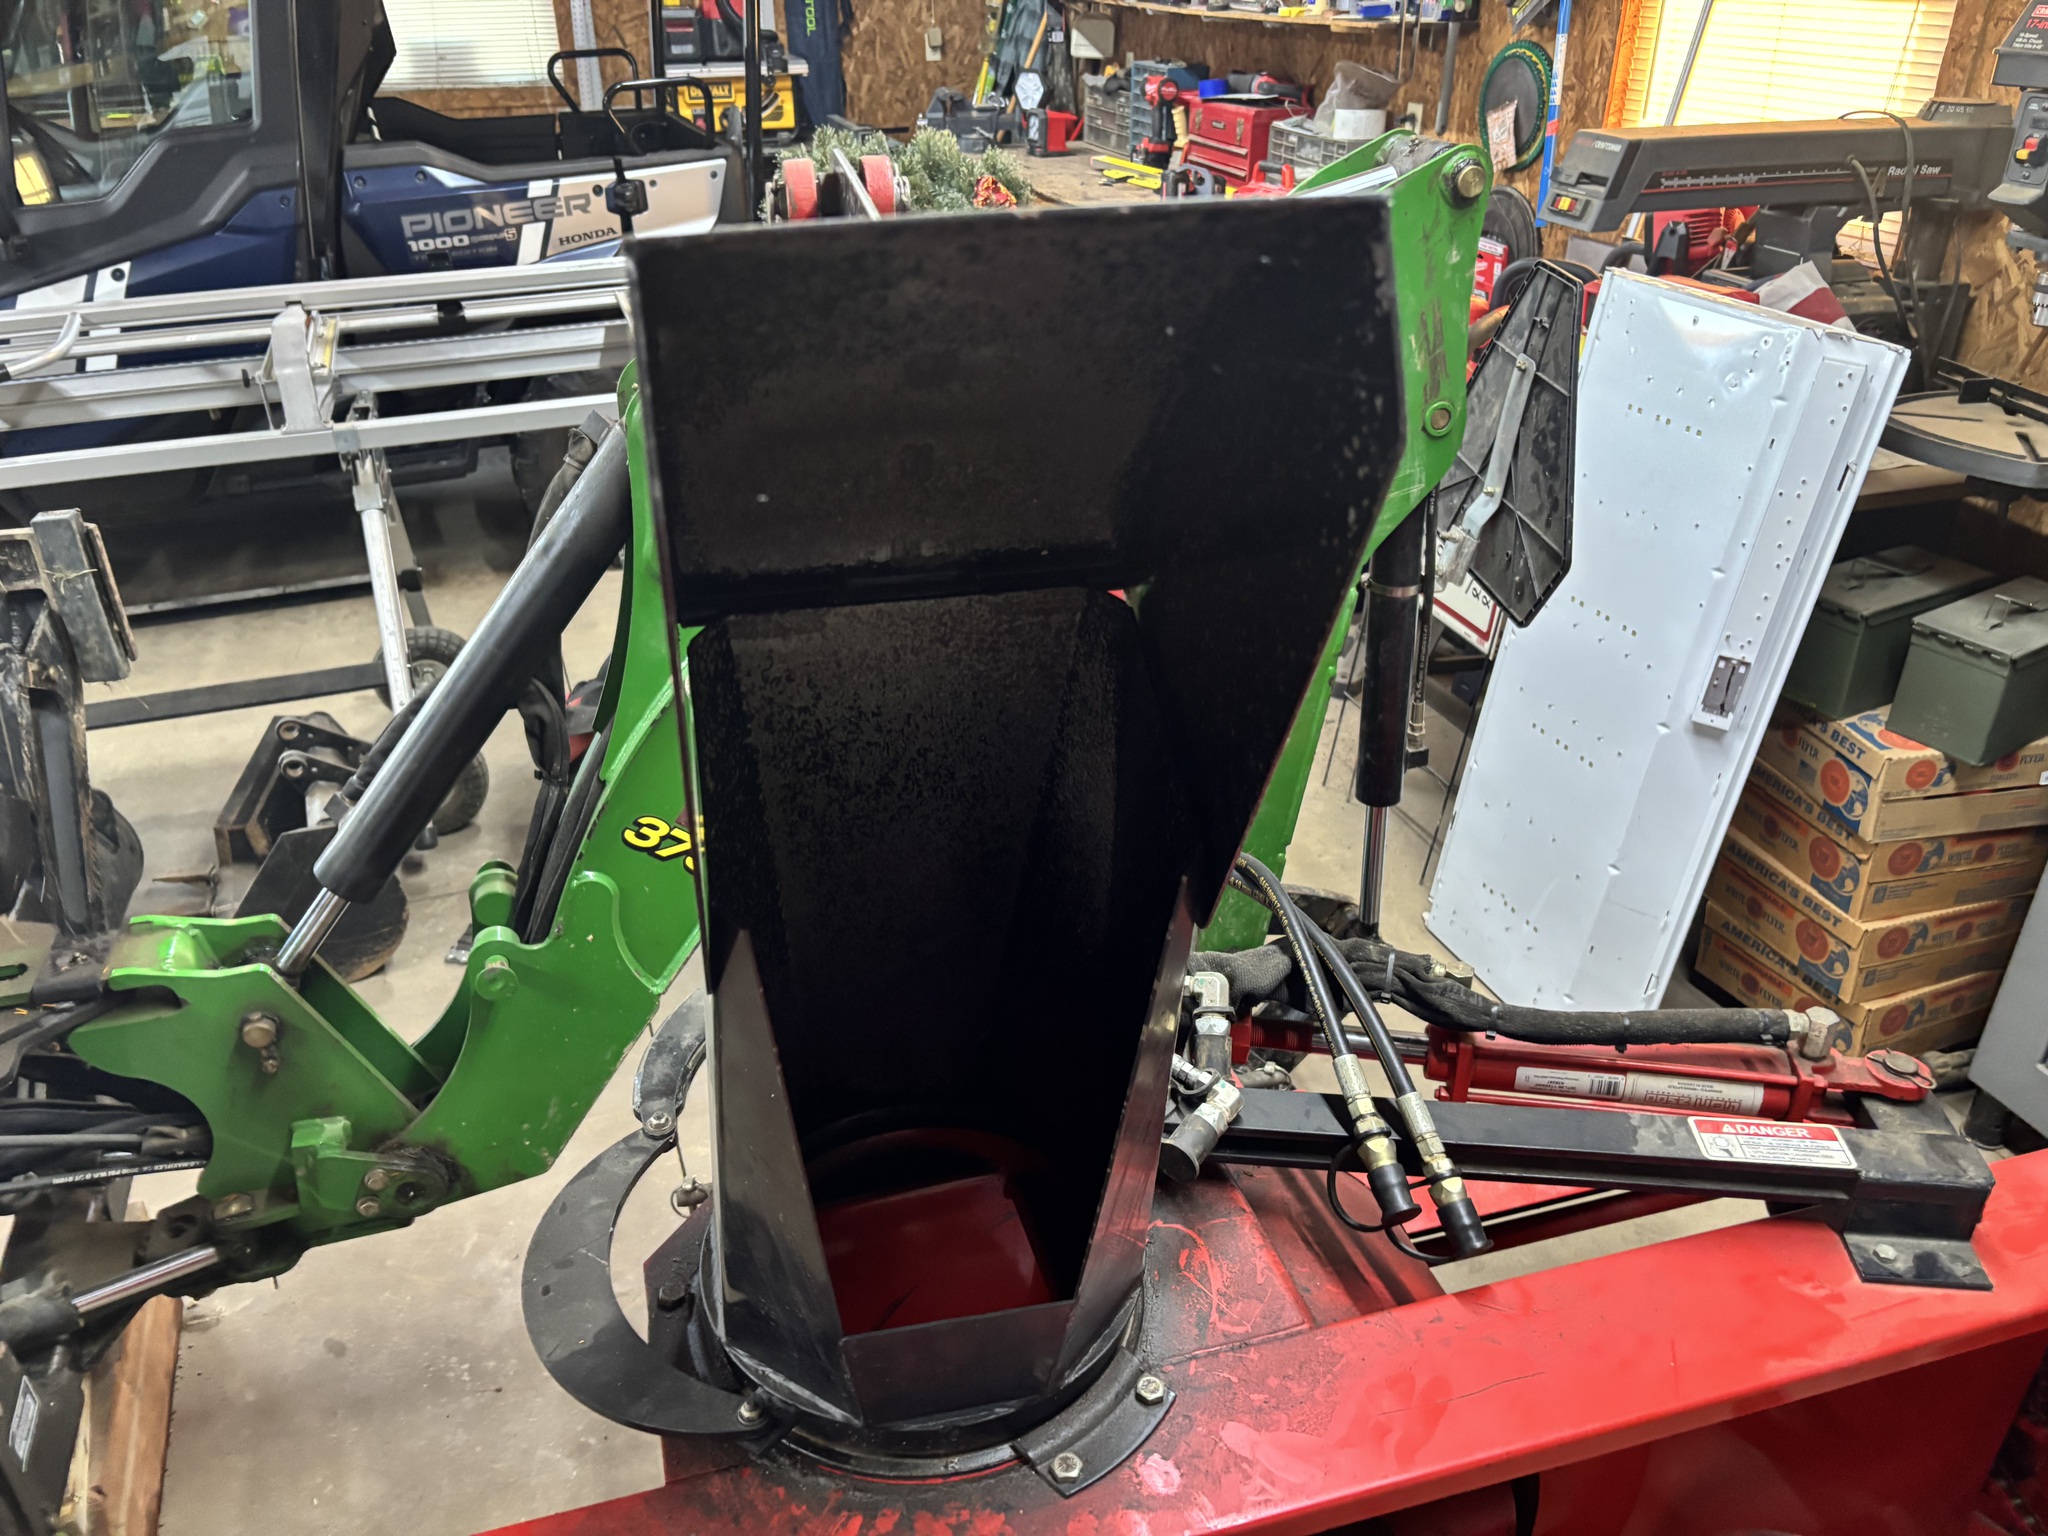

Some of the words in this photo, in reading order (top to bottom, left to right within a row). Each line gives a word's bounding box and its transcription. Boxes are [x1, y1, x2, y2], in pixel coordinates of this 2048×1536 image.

[1920, 164, 1941, 175] Saw
[401, 193, 592, 238] PIONEER
[407, 234, 470, 252] 1000
[558, 226, 618, 247] HONDA
[1830, 729, 1866, 760] BEST
[1816, 809, 1855, 841] BEST
[1727, 842, 1799, 900] AMERICA'S
[1802, 895, 1842, 928] BEST
[1721, 920, 1799, 976] AMERICA'S
[1735, 1123, 1812, 1139] DANGER
